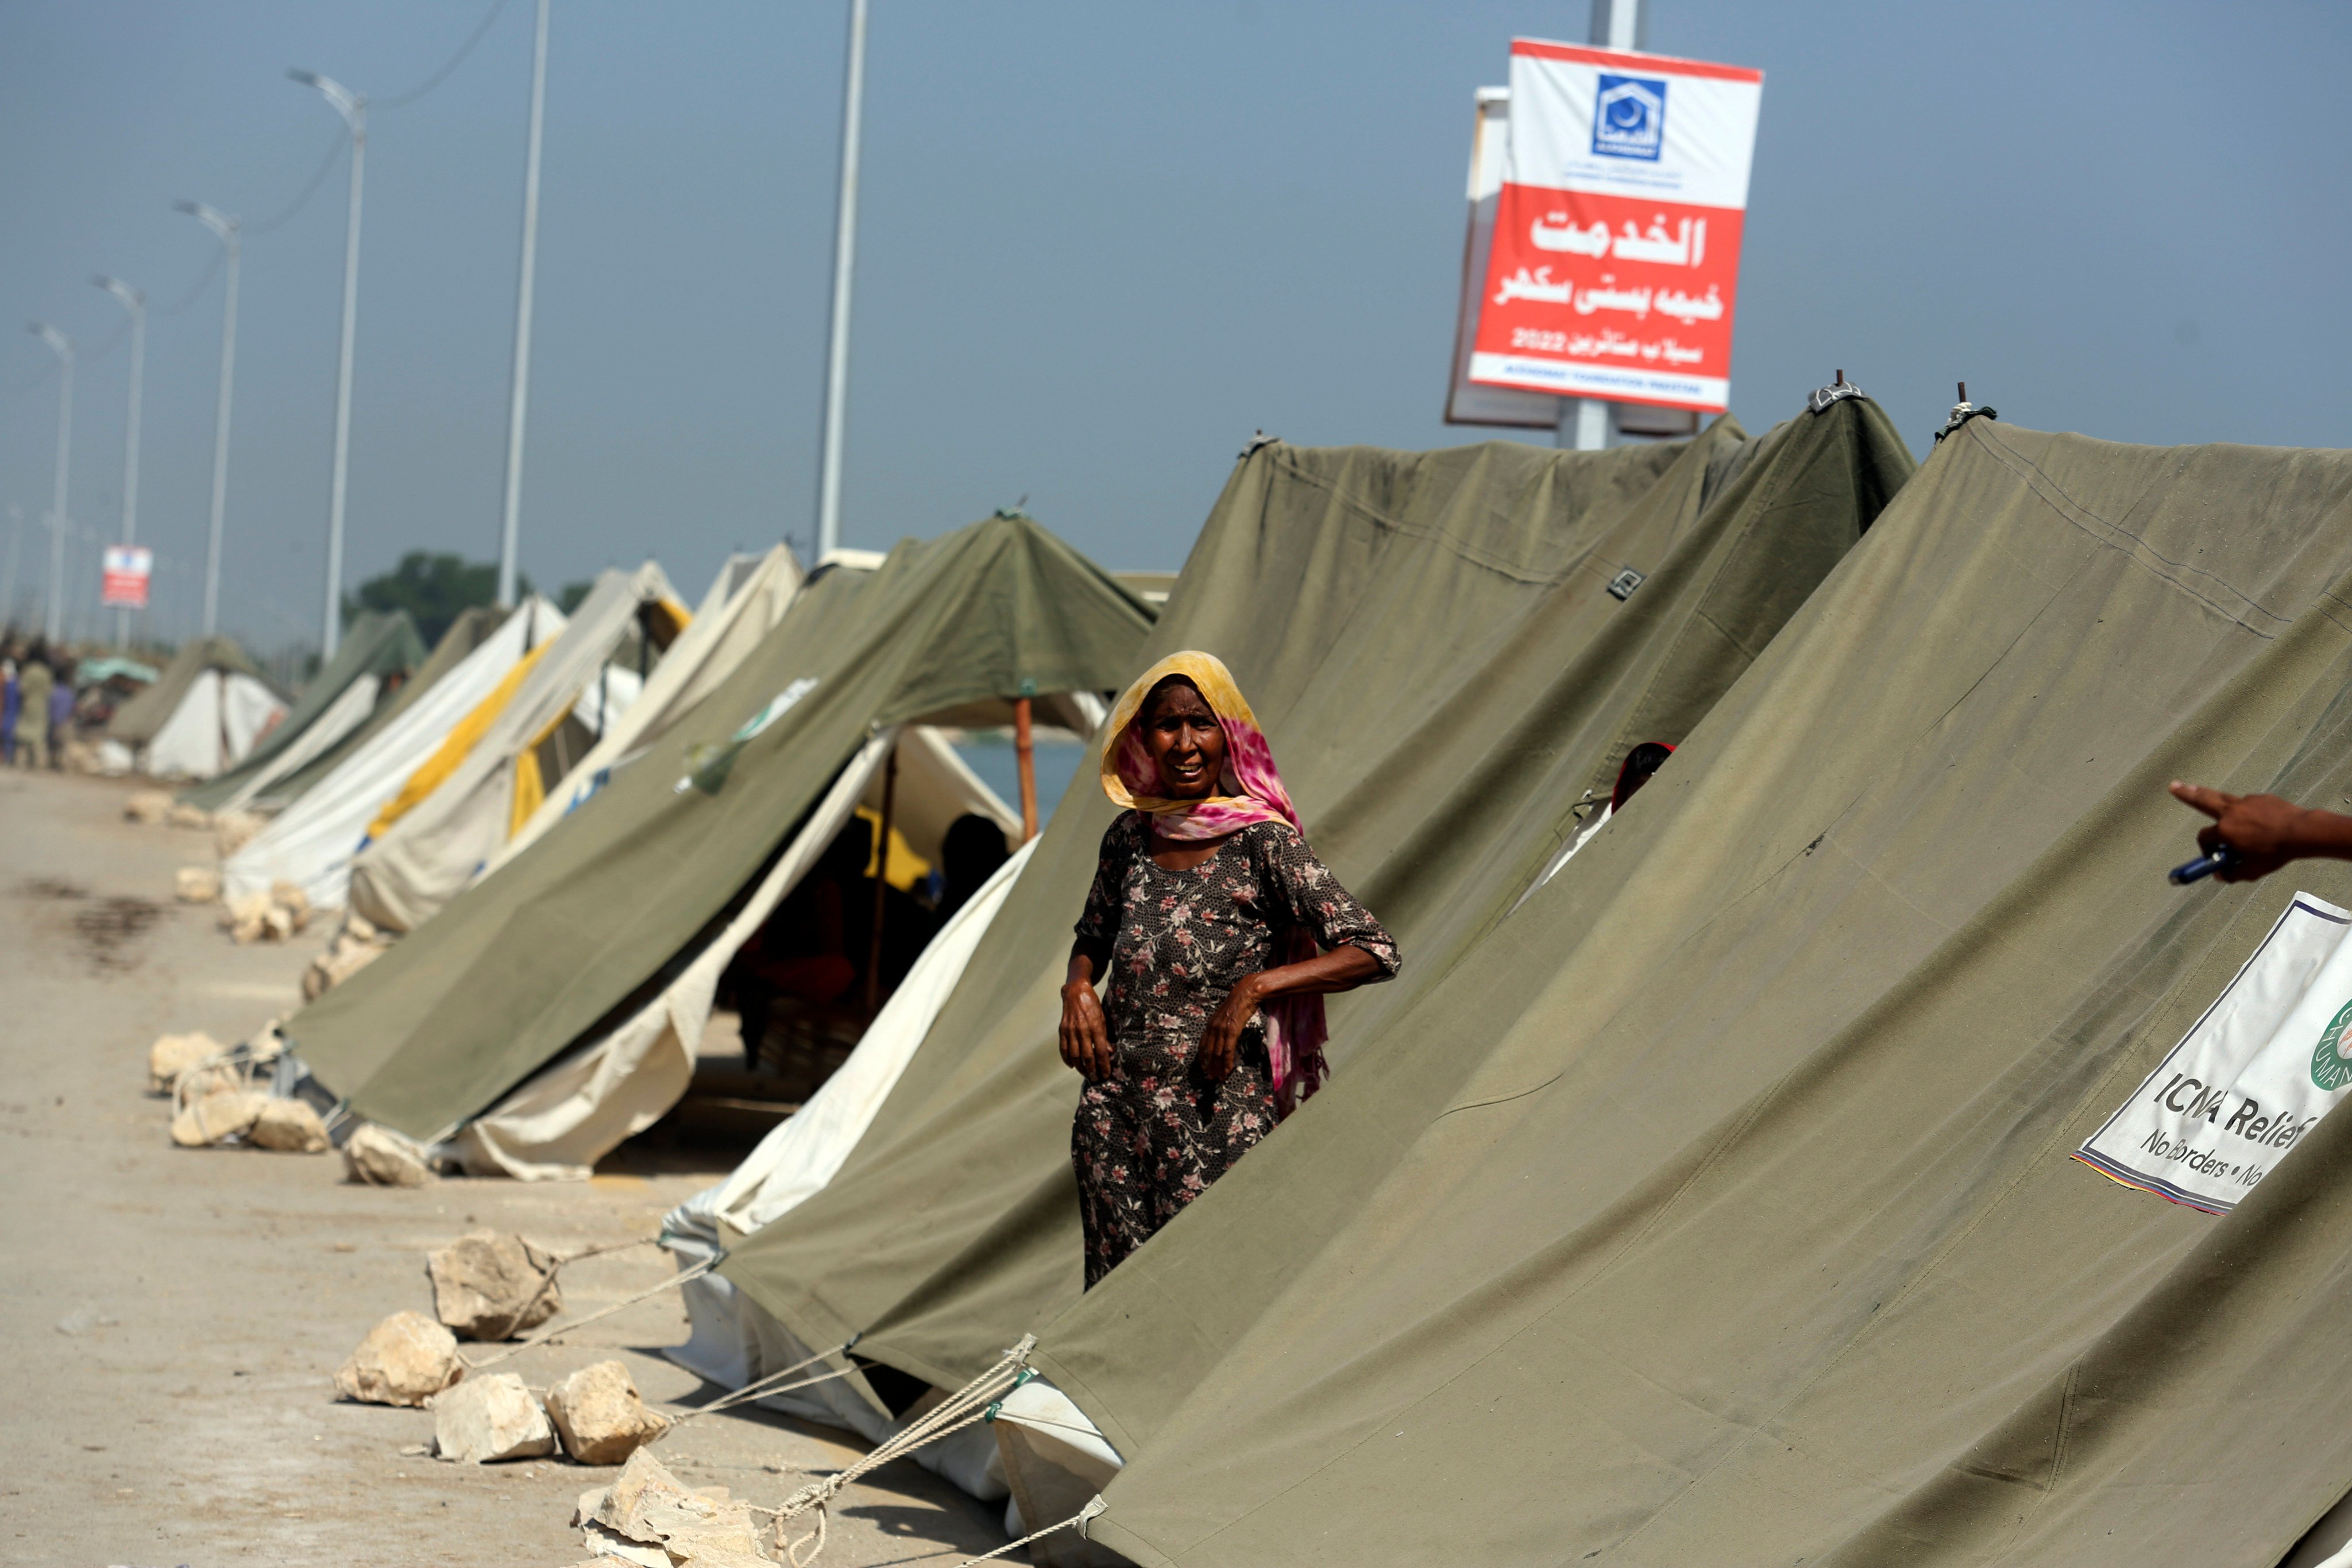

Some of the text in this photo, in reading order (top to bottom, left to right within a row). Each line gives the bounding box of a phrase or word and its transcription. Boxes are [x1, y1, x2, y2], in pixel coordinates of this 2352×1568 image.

[1530, 211, 1707, 268] الخدمت
[1511, 327, 1567, 352] 2022
[2153, 1073, 2318, 1149] ICNA Relief
[2140, 1129, 2262, 1187] No Borders No
